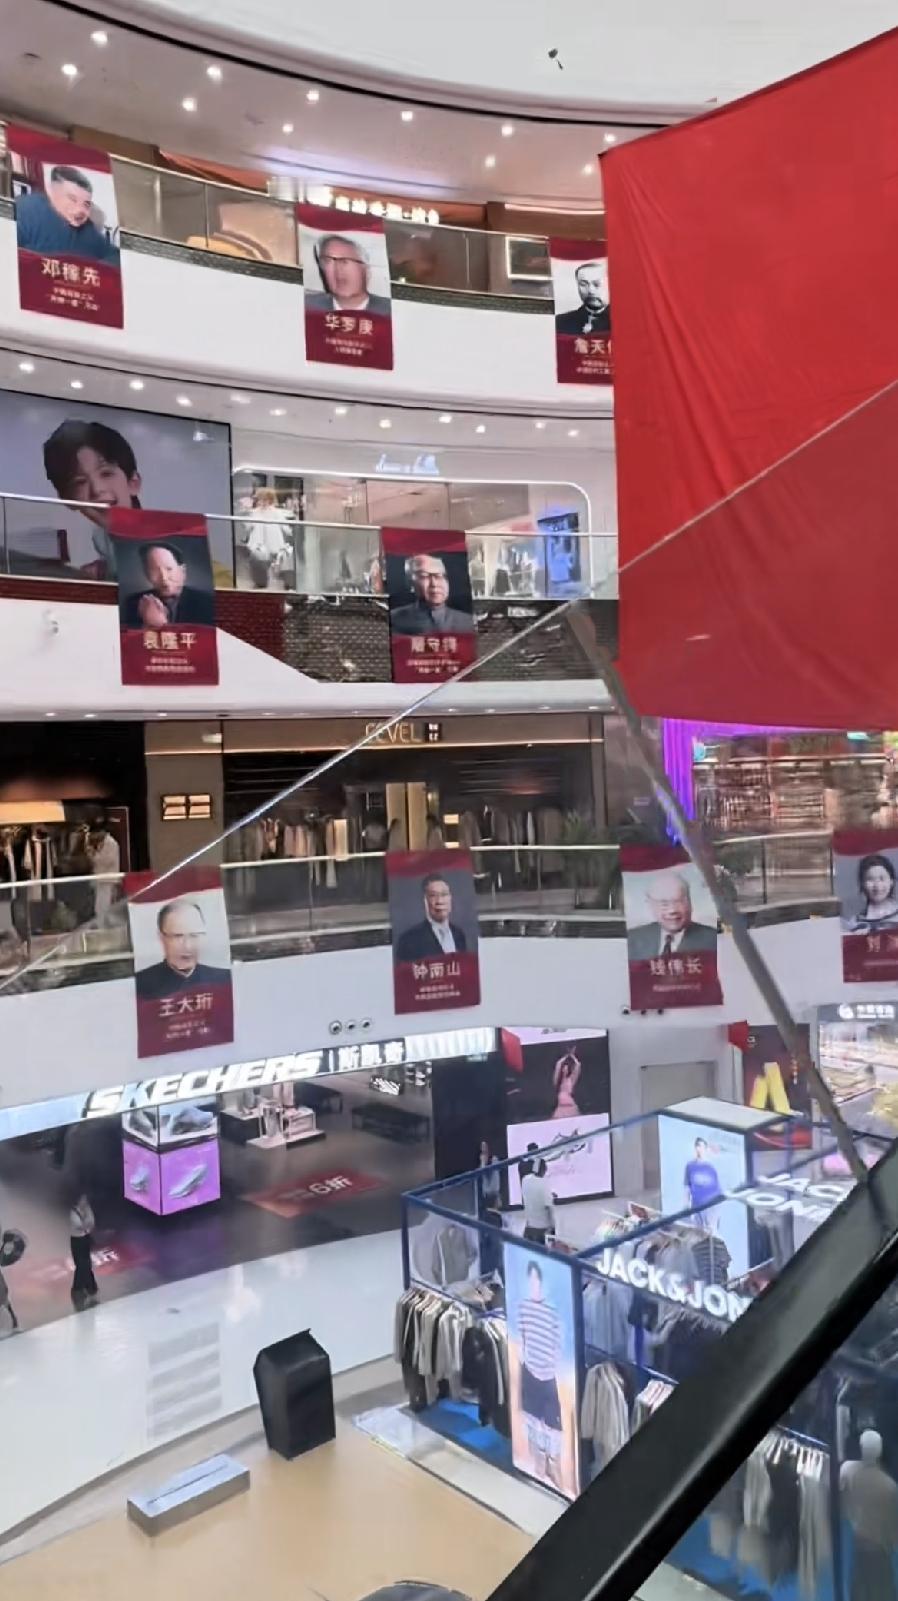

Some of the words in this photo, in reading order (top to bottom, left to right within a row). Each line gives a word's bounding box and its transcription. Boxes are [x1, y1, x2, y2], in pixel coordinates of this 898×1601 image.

[41, 257, 101, 288] 邓稼先
[143, 630, 198, 650] 袁隆平
[412, 960, 461, 980] 钟南山
[85, 1050, 324, 1119] SKECHERS
